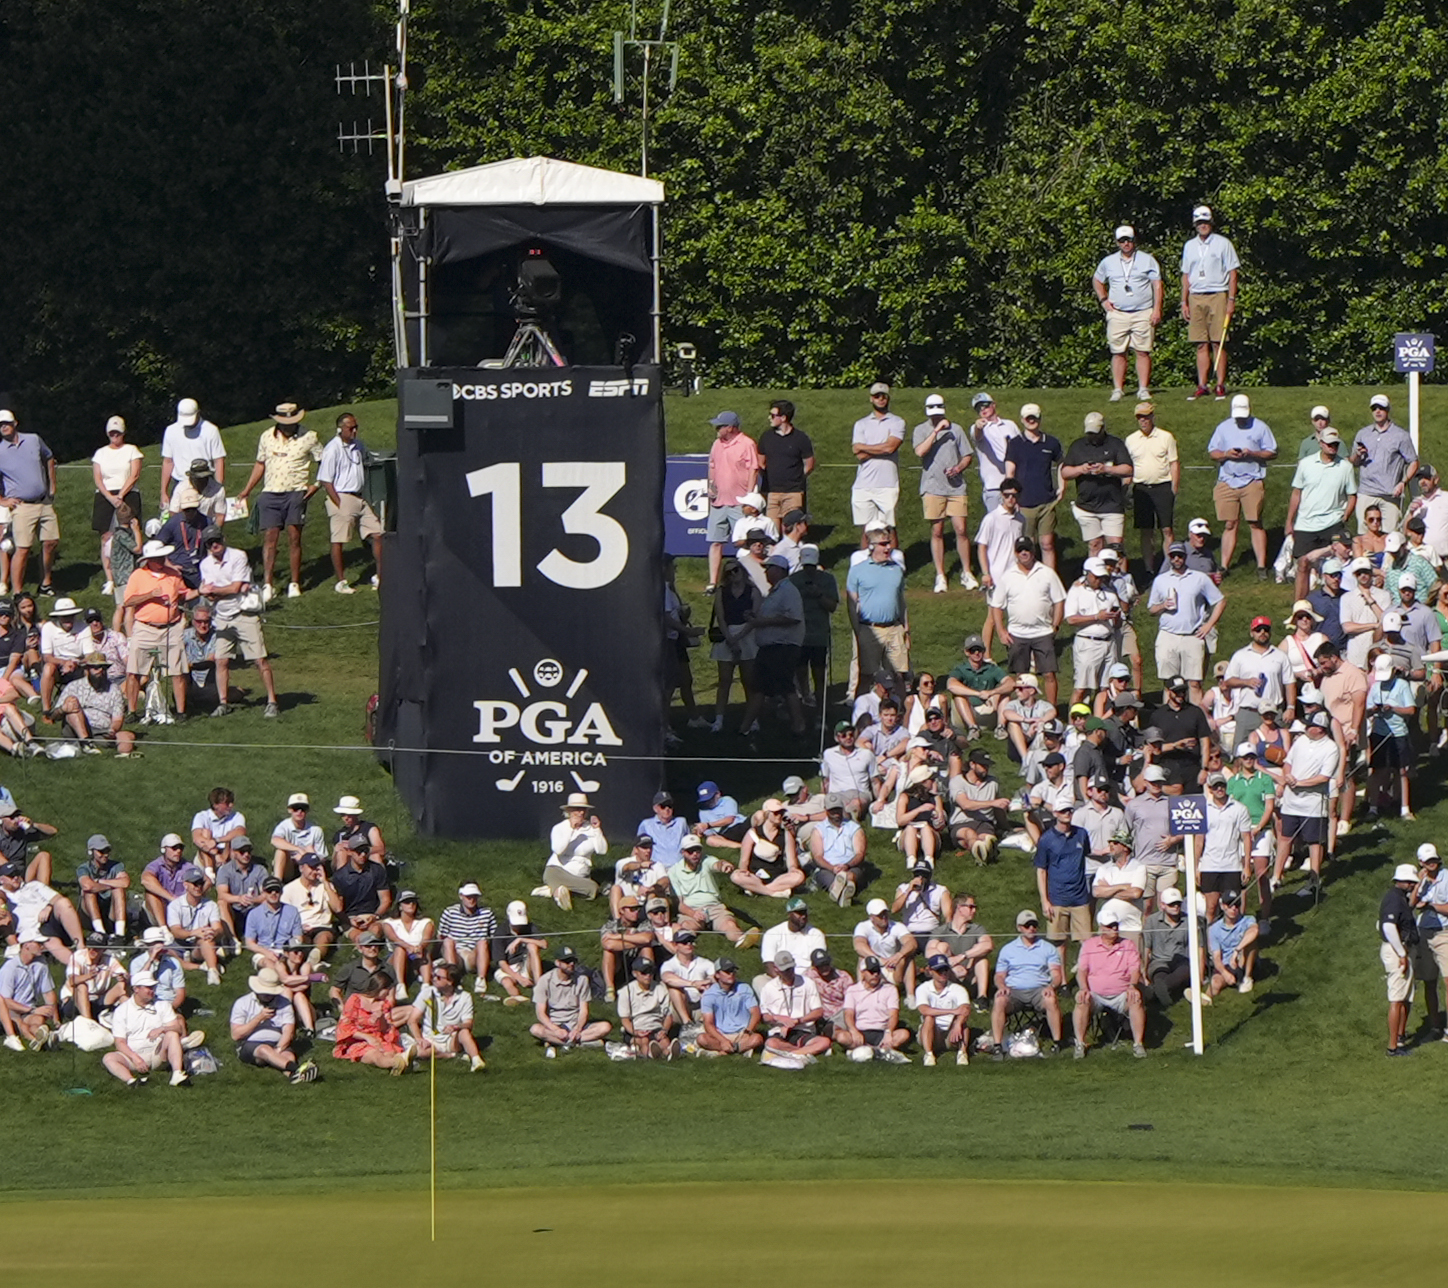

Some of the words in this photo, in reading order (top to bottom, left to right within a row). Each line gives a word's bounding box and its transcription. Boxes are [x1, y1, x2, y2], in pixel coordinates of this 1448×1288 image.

[1398, 347, 1430, 358] PGA
[461, 384, 498, 400] CBS
[500, 380, 573, 399] SPORTS
[588, 378, 650, 397] ESPN
[465, 461, 629, 590] 13
[473, 700, 623, 746] PGA
[489, 750, 516, 764] OF
[520, 751, 608, 766] AMERICA
[531, 780, 564, 793] 1916
[1171, 809, 1204, 820] PGA
